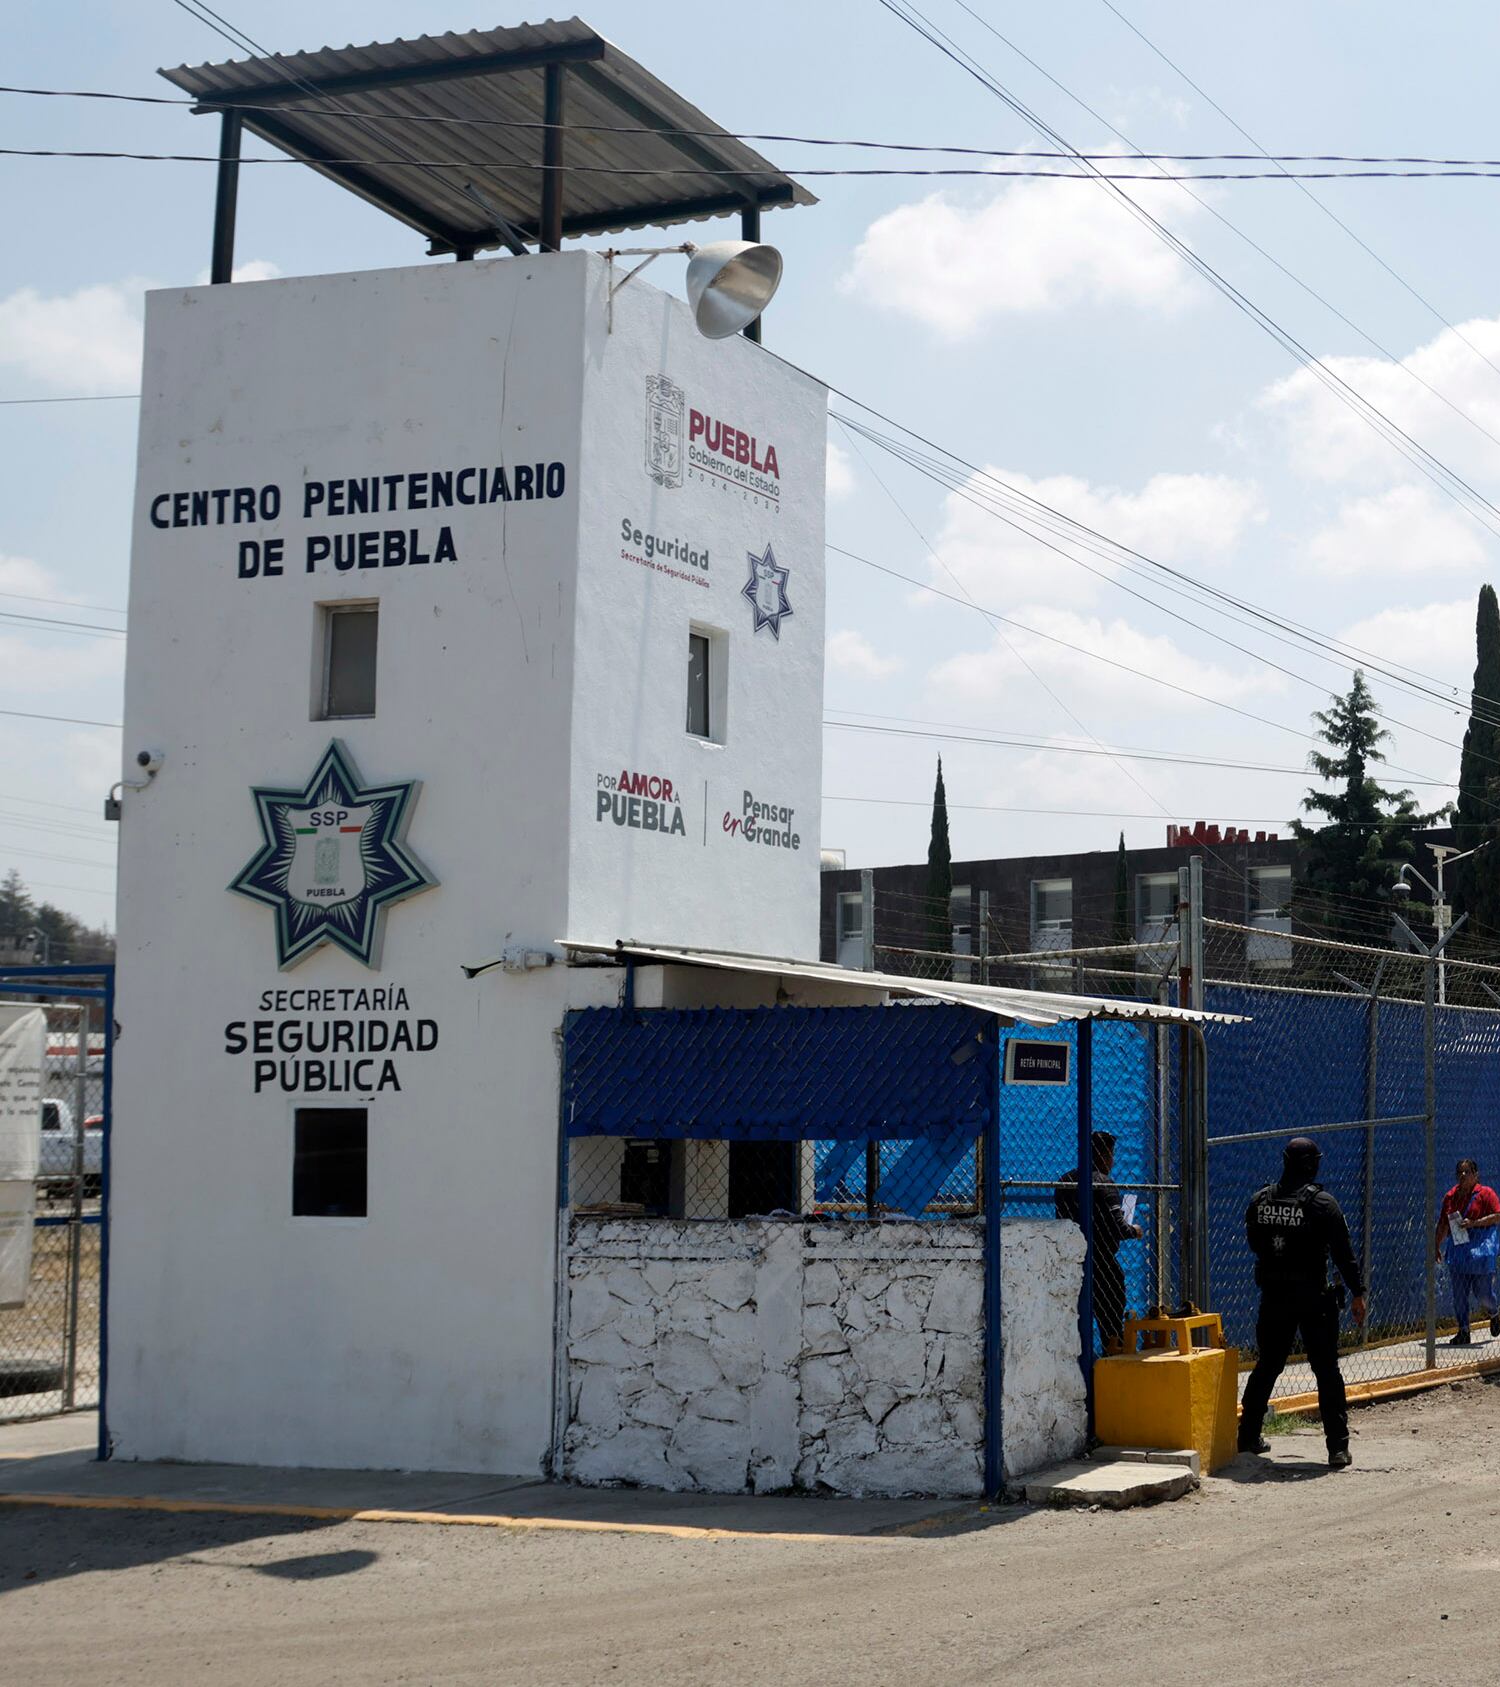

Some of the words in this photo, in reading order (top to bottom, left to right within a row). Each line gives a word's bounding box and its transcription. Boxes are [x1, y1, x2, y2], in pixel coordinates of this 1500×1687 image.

[689, 408, 780, 481] PUEBLA
[688, 445, 732, 476] Gobierno
[733, 464, 748, 484] del
[749, 471, 780, 497] Estado
[150, 484, 281, 529] CENTRO
[303, 461, 566, 518] PENITENCIARIO
[238, 539, 284, 579] DE
[306, 526, 458, 574] PUEBLA
[621, 518, 709, 571] Seguridad
[597, 773, 617, 791] POR
[617, 770, 673, 803] AMOR
[674, 792, 681, 804] A
[309, 811, 349, 827] SSP
[596, 790, 686, 837] PUEBLA
[742, 790, 795, 824] Pensar
[744, 815, 801, 850] Grande
[306, 888, 346, 897] PUEBLA
[258, 983, 411, 1011] SECRETARÍA
[224, 1019, 439, 1054] SEGURIDAD
[254, 1054, 402, 1093] PÚBLICA
[1036, 1058, 1062, 1070] PRINCIPAL
